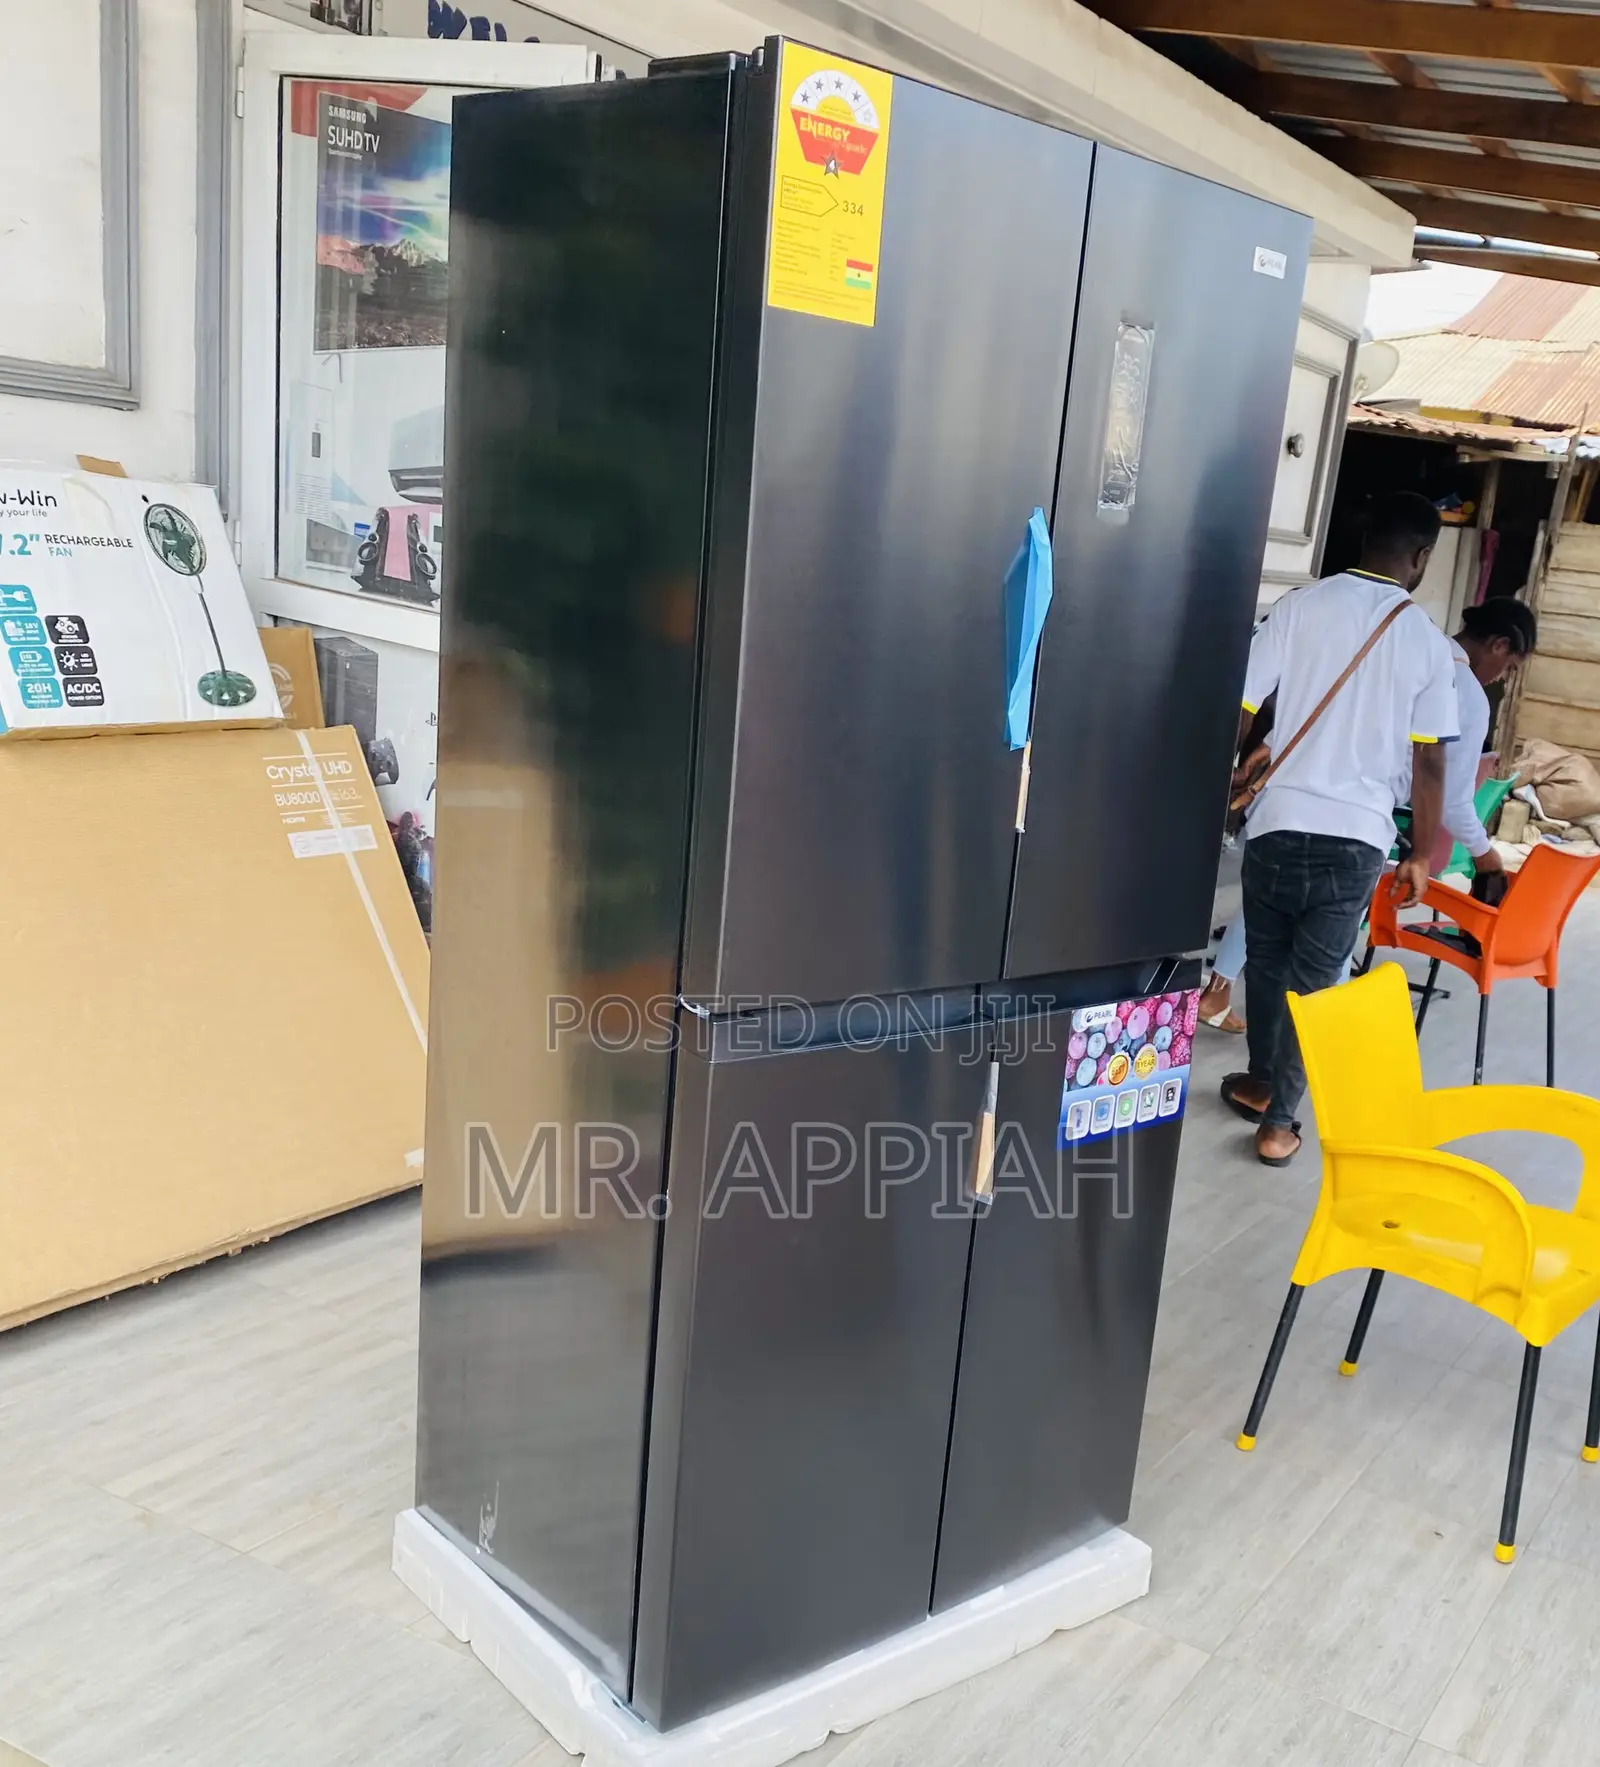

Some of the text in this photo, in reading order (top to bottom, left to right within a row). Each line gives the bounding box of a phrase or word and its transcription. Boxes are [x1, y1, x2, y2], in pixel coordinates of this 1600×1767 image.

[328, 105, 367, 124] SAMSUNG
[800, 114, 850, 142] ENERGY
[842, 200, 864, 216] 334
[6, 509, 29, 518] your
[32, 508, 48, 518] life
[44, 533, 134, 548] RECHARGEABLE
[48, 546, 73, 558] FAN
[26, 683, 52, 694] 20H
[67, 683, 101, 694] AC/DC
[323, 760, 352, 776] UHD
[274, 791, 321, 806] BU8000
[1094, 1010, 1113, 1019] PEARL
